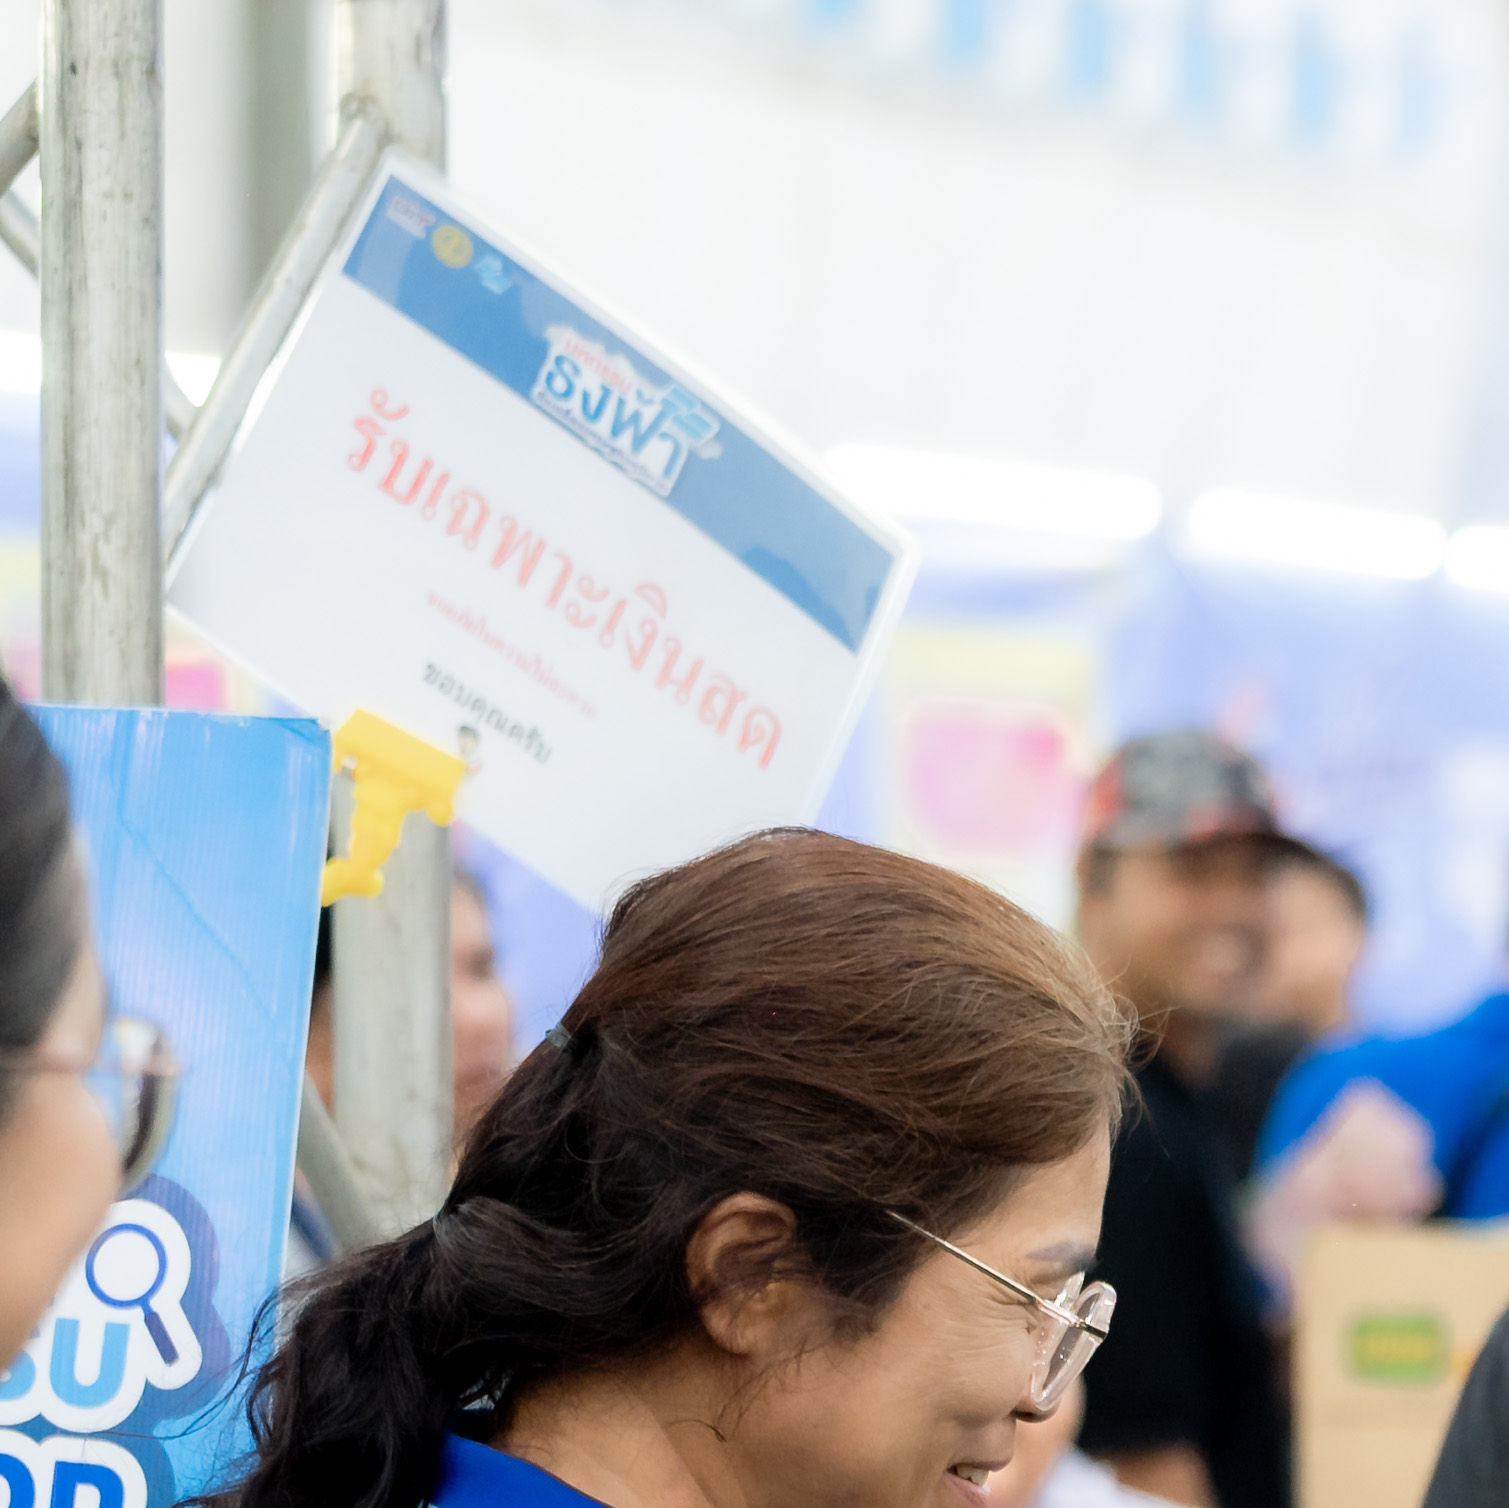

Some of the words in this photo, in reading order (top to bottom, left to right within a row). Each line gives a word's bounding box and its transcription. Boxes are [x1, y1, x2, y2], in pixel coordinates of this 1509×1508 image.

[347, 386, 784, 770] รับเฉพาะเงินสด
